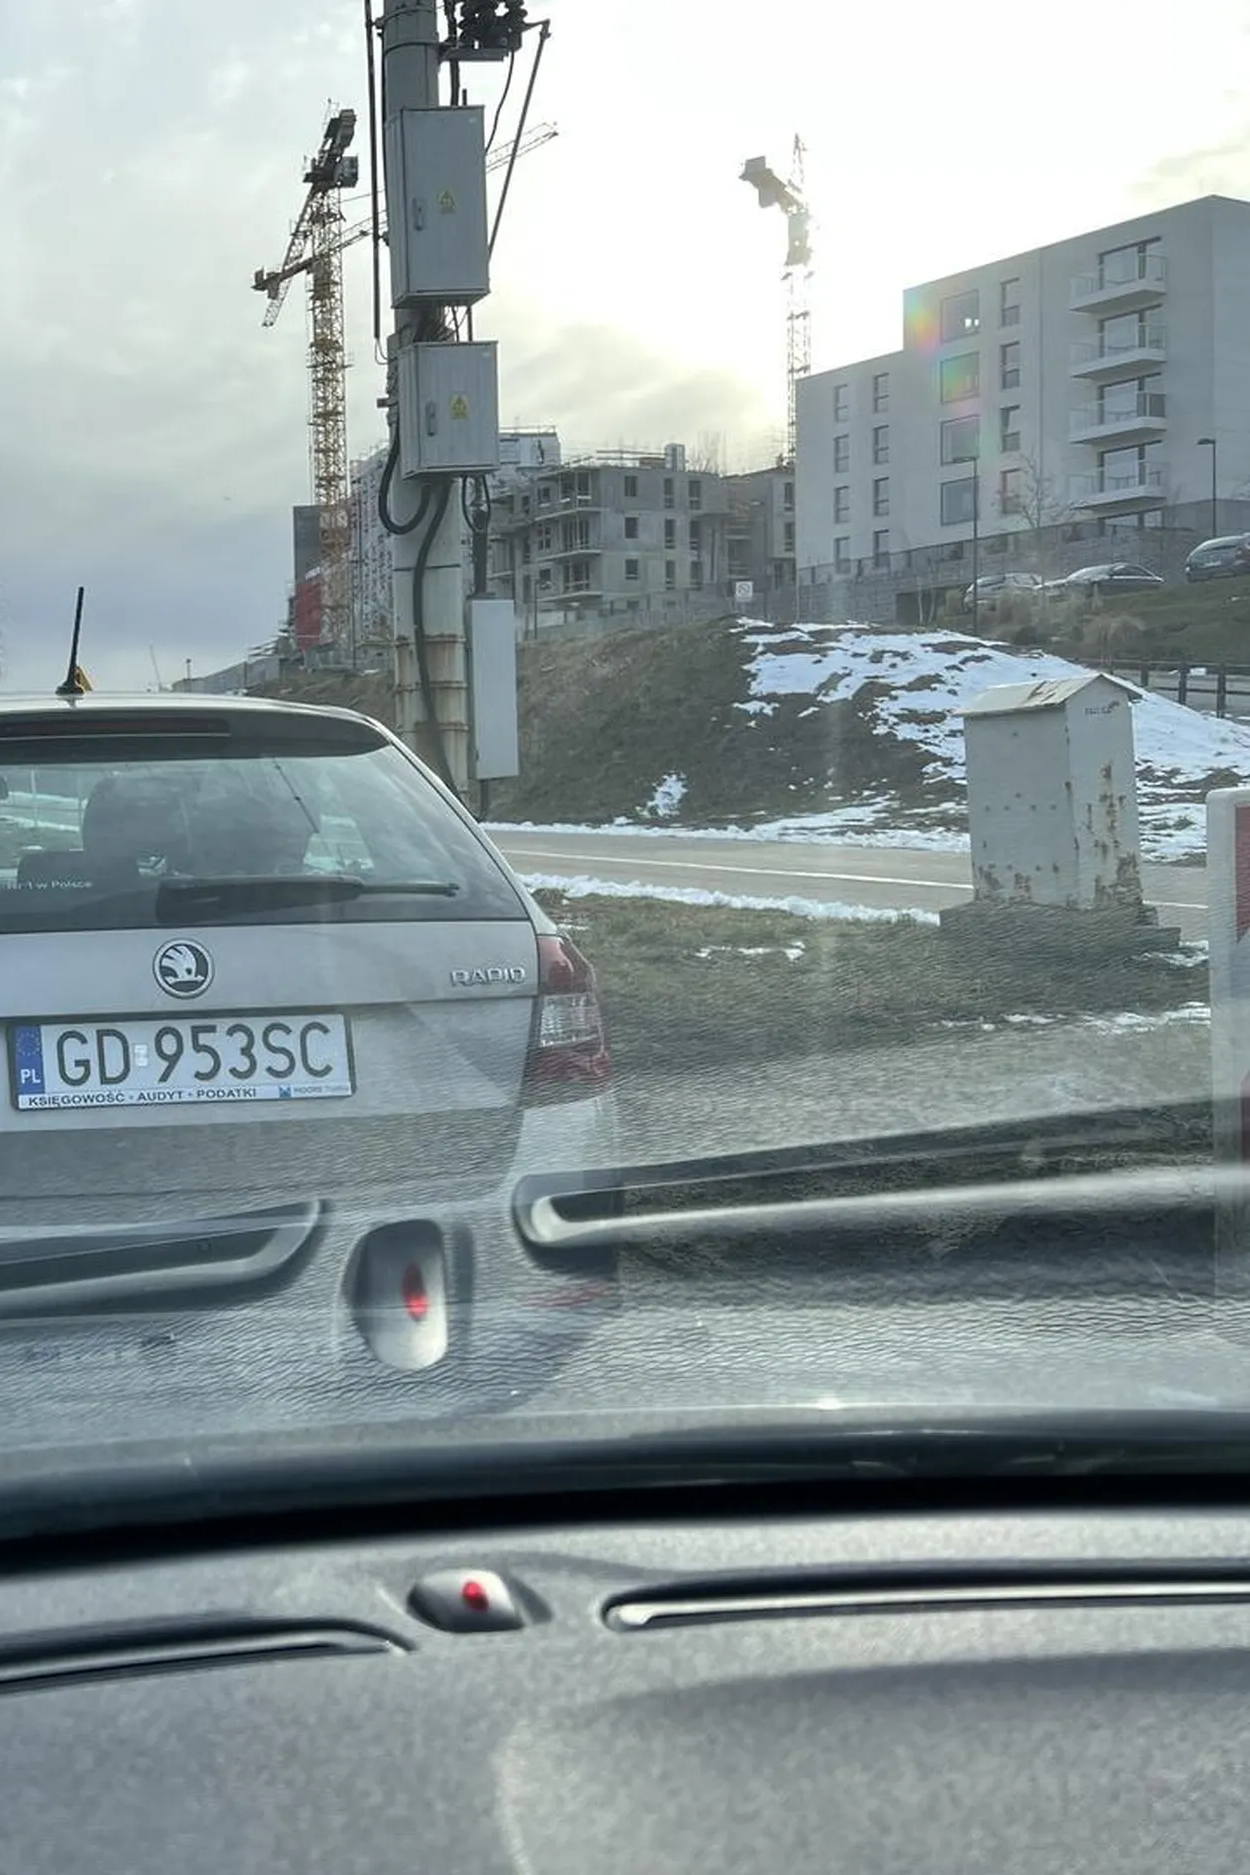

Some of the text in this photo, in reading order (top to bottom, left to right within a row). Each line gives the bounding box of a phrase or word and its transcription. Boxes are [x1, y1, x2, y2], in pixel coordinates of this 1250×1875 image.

[450, 966, 526, 987] RAPID
[56, 1021, 333, 1087] GD 953SC
[20, 1068, 41, 1085] PL
[138, 1090, 183, 1101] AUDYT
[196, 1088, 257, 1099] PODATKI
